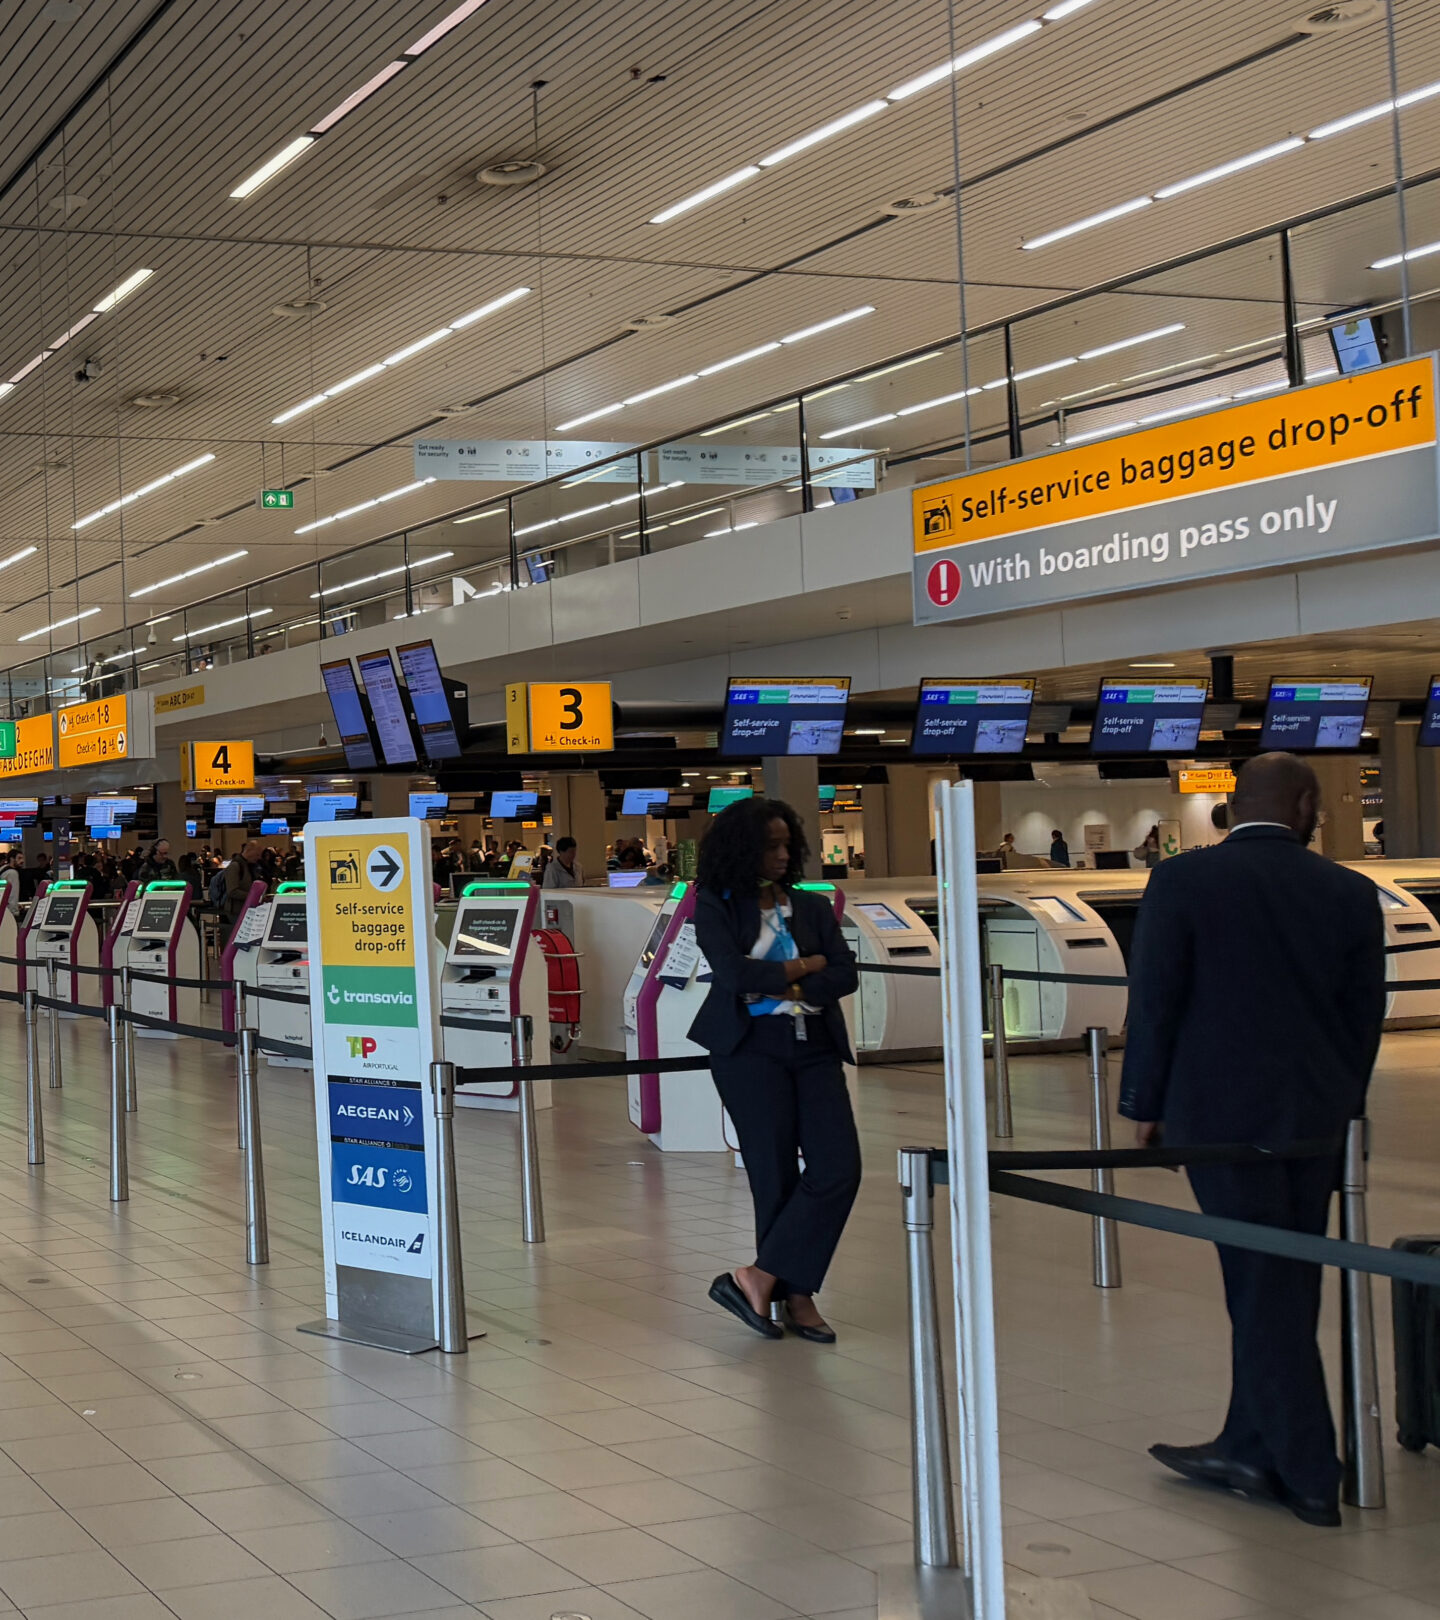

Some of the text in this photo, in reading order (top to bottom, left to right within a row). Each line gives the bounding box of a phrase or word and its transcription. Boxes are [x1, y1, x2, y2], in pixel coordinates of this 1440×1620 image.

[961, 385, 1423, 523] Self-service baggage drop-off
[969, 494, 1338, 588] With boarding pass only
[75, 704, 110, 725] Check-in 1-8
[559, 688, 584, 730] 3
[733, 719, 780, 727] Self-service
[925, 719, 968, 727] Self-service
[1103, 717, 1144, 725] Self-service
[732, 728, 766, 737] drop-off
[923, 727, 955, 736] drop-off
[1102, 726, 1132, 734] drop-off
[76, 736, 107, 755] Check-in 1a
[559, 736, 600, 745] Check-in
[212, 745, 232, 774] 4
[335, 902, 404, 915] Self-service
[352, 921, 405, 936] baggage
[355, 939, 406, 954] drop-off
[343, 990, 413, 1005] transavia
[346, 1036, 377, 1058] TAP
[337, 1105, 400, 1121] AEGEAN
[359, 1139, 385, 1148] ALLIANCE
[346, 1164, 389, 1188] SAS
[341, 1230, 406, 1248] ICELANDAIR
